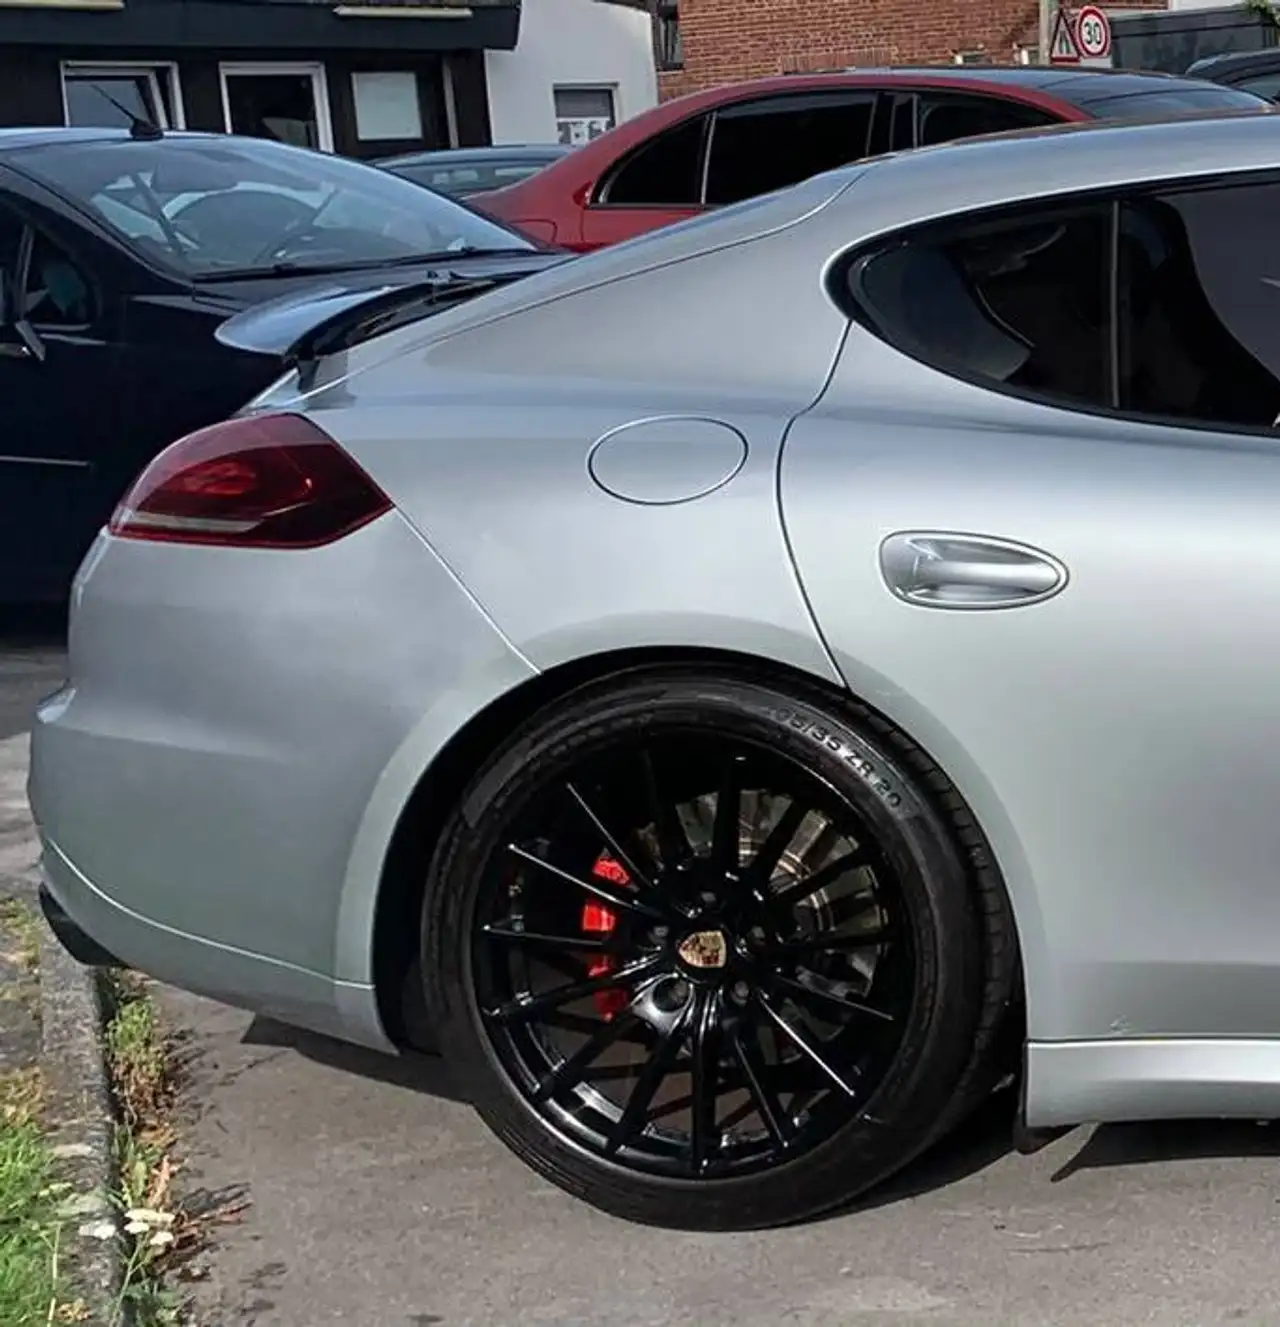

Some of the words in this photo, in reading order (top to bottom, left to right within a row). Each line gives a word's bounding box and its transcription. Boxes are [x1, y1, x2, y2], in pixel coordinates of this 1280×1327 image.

[1084, 21, 1102, 45] 30
[844, 749, 874, 777] ZR
[872, 778, 901, 808] 20
